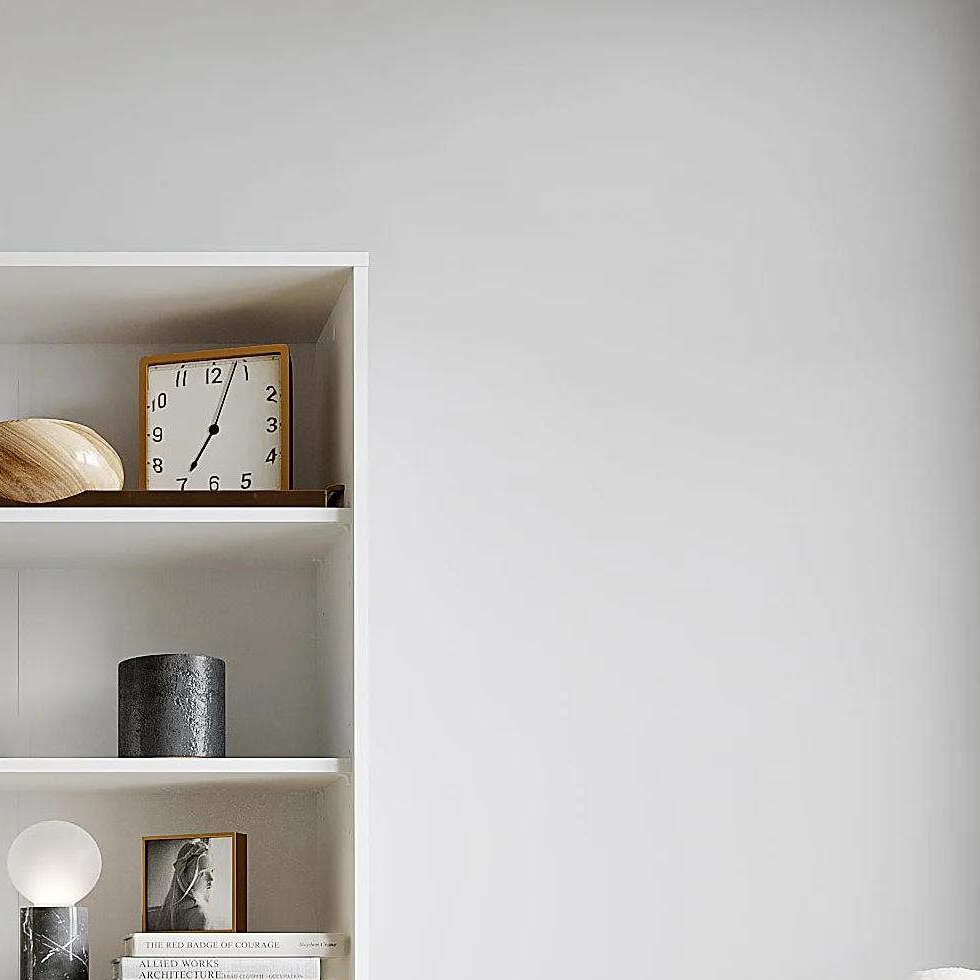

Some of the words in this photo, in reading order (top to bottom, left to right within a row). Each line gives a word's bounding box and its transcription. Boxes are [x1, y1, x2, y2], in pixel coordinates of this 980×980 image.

[175, 370, 187, 387] 11
[205, 367, 223, 385] 12
[243, 364, 249, 381] 1
[151, 392, 167, 412] 10
[265, 385, 278, 403] 2
[266, 417, 278, 433] 3
[152, 426, 163, 443] 9
[265, 448, 278, 465] 4
[152, 458, 163, 473] 8
[175, 477, 188, 491] 7
[209, 475, 220, 491] 6
[240, 472, 252, 489] 5
[145, 941, 164, 949] THE
[166, 941, 185, 949] RED
[186, 941, 219, 949] BADGE
[220, 941, 233, 949] OF
[235, 940, 280, 949] COURAGE
[139, 959, 179, 968] ALLIED
[181, 959, 219, 968] WORKS
